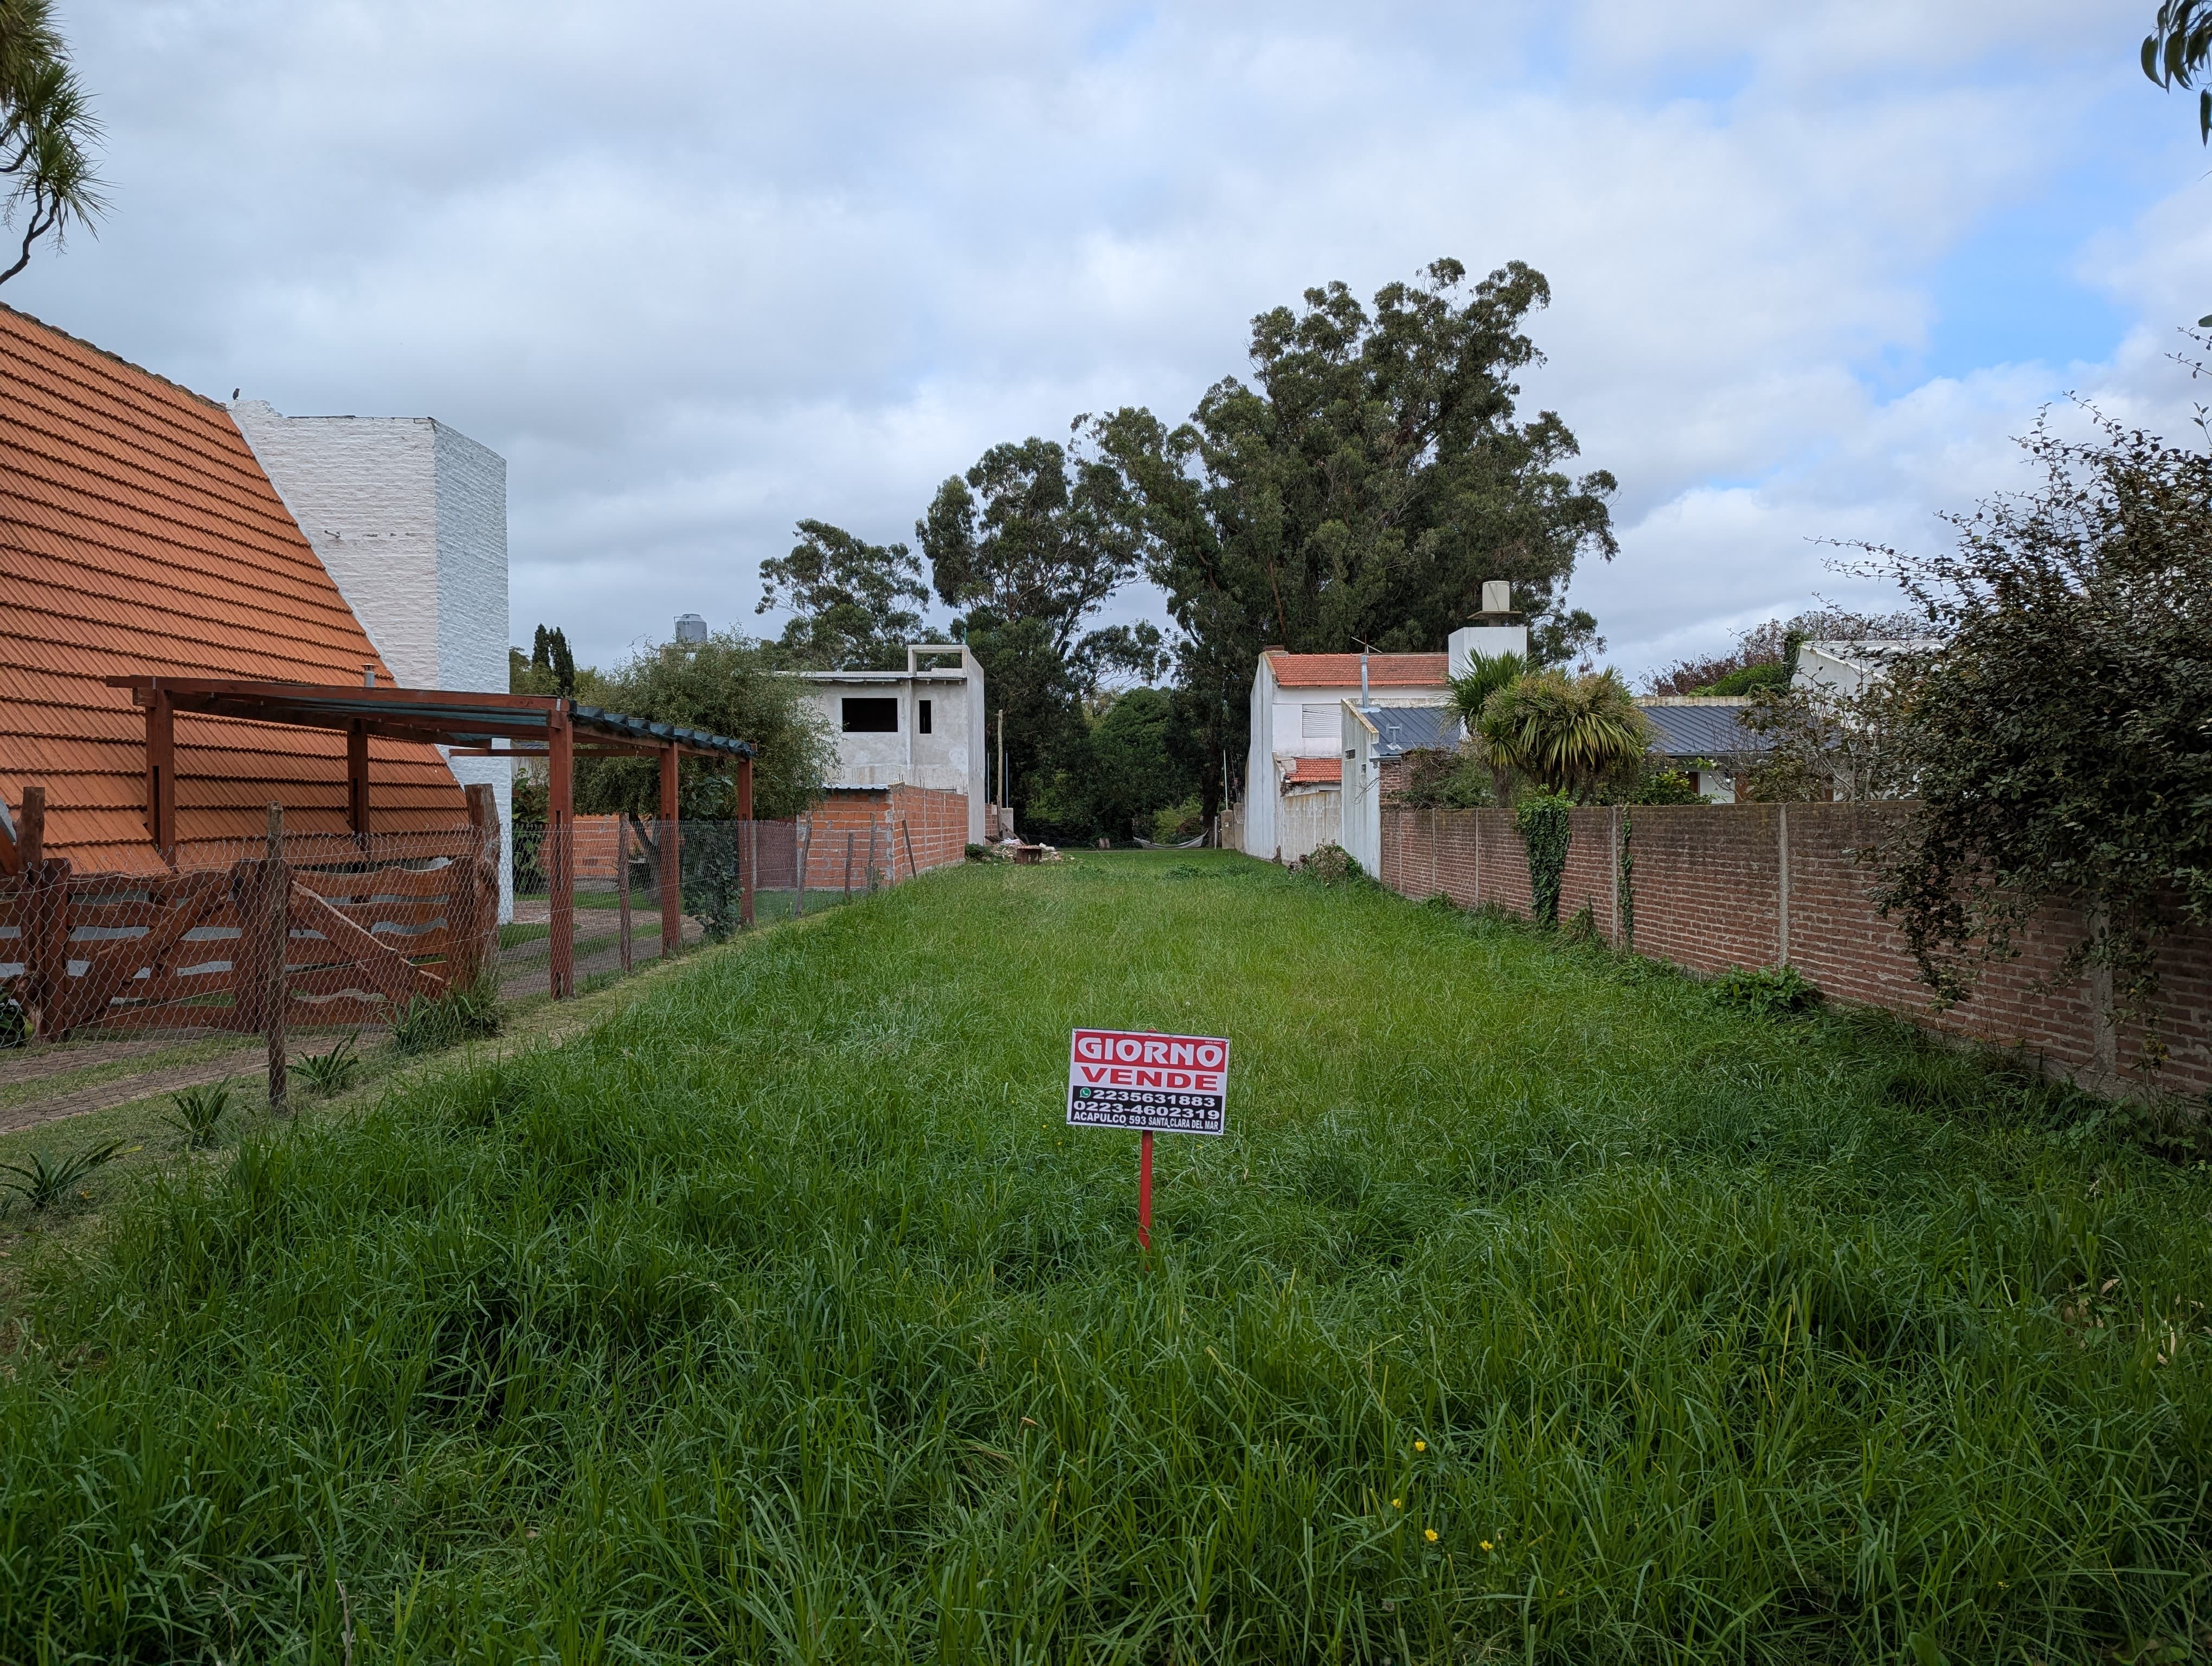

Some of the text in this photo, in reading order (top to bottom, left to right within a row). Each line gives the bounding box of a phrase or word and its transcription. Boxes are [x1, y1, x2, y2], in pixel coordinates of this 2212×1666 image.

[1078, 1037, 1223, 1067] GIORNO
[1081, 1066, 1218, 1091] VENDE
[1092, 1089, 1215, 1107] 2235631883
[1073, 1100, 1220, 1119] 0223-4602319
[1073, 1111, 1218, 1130] ACAPULCO 593 SANTA CLARA DEL MAR
